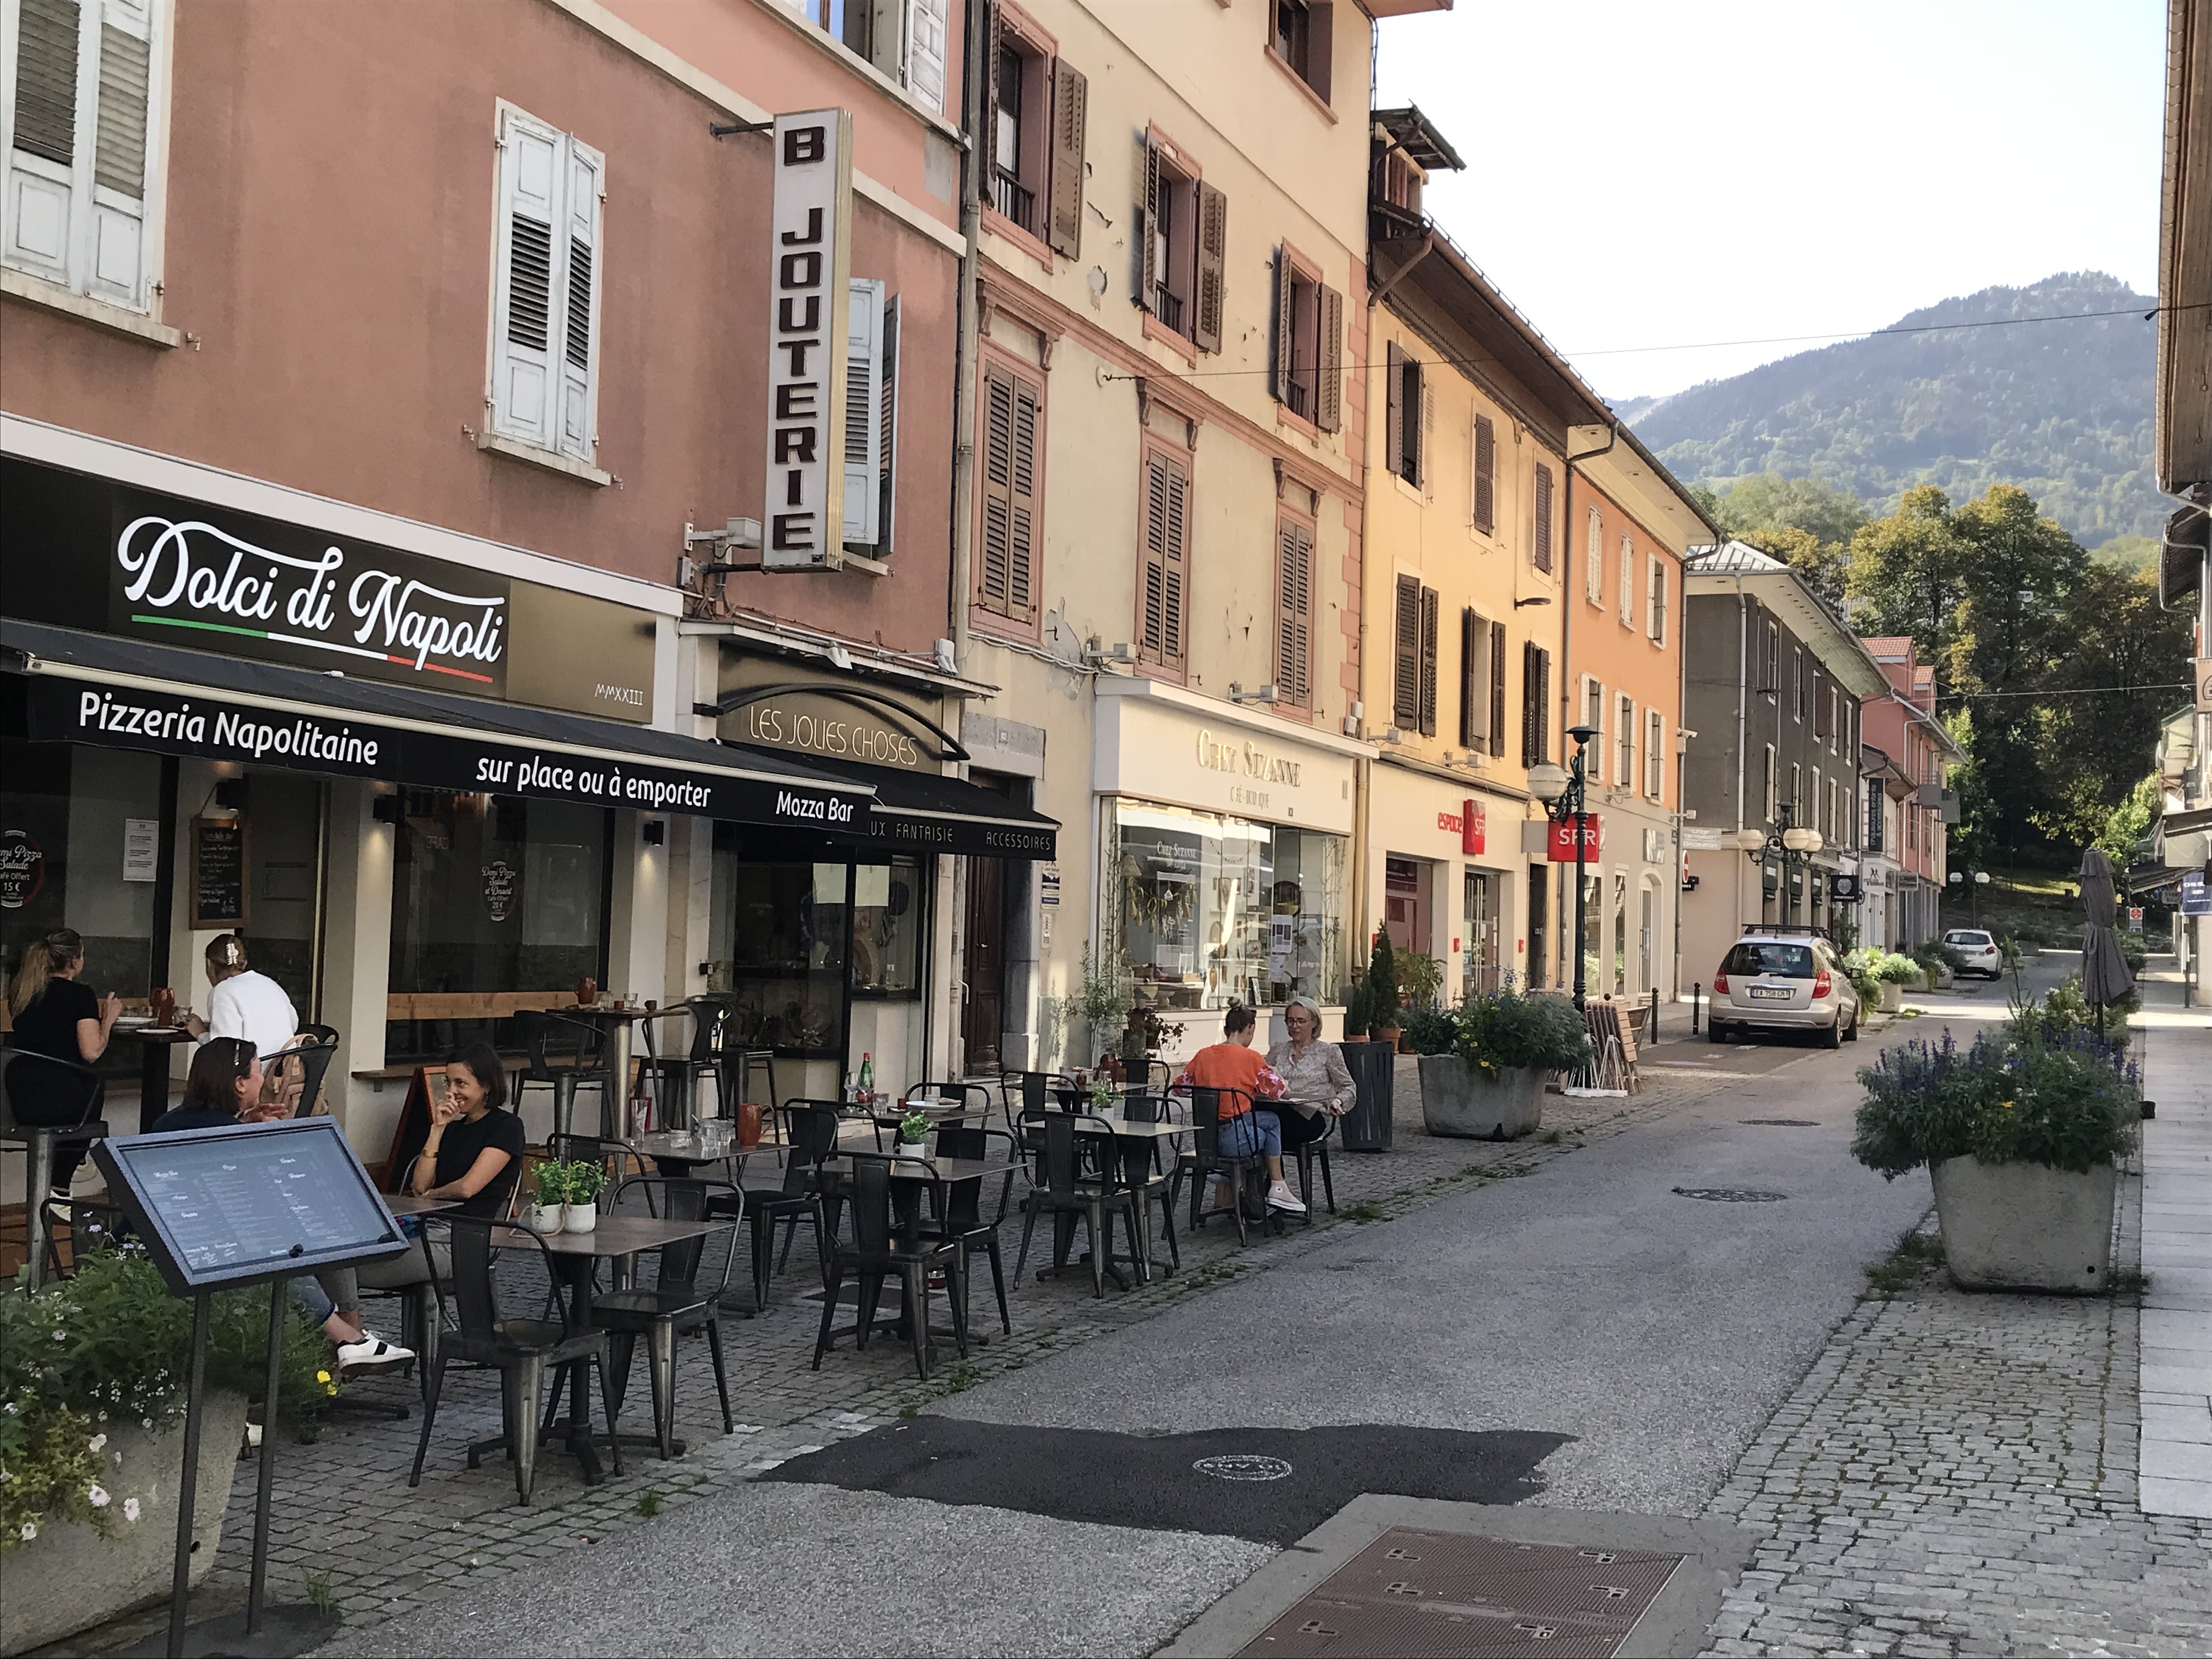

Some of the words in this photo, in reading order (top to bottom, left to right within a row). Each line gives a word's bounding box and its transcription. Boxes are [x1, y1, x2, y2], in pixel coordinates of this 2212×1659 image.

[117, 516, 278, 620] Dolci
[286, 546, 343, 630] di
[348, 569, 505, 670] Napoli
[595, 683, 644, 706] MMXXIII
[80, 691, 206, 743] Pizzeria
[213, 712, 379, 765] Napolitaine
[749, 706, 782, 742] LES
[787, 714, 847, 753] JOLIES
[852, 727, 917, 765] CHOSES
[476, 756, 514, 782] sur
[517, 755, 573, 792] place
[578, 771, 604, 796] ou
[608, 766, 621, 797] à
[625, 777, 712, 808] emporter
[776, 791, 824, 819] Mozza
[827, 797, 854, 822] Bar
[895, 822, 953, 843] FANTAISIE
[986, 831, 1051, 851] ACCESSOIRES
[14, 845, 43, 862] Pizza
[3, 882, 13, 891] 15
[15, 882, 21, 891] €
